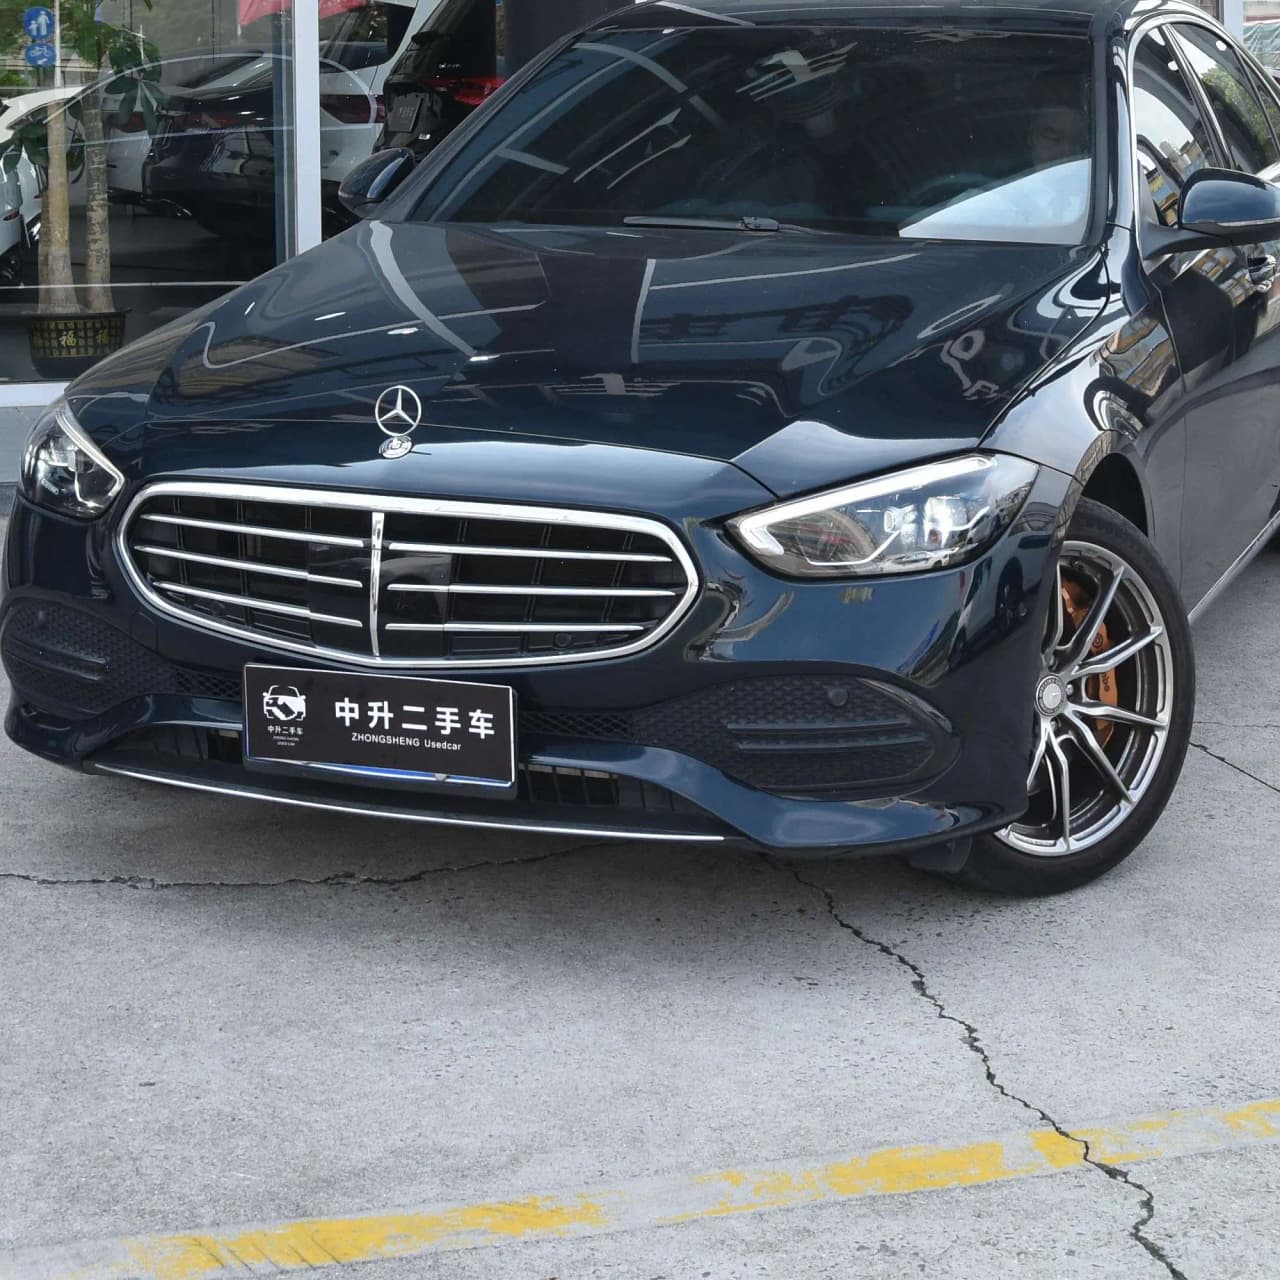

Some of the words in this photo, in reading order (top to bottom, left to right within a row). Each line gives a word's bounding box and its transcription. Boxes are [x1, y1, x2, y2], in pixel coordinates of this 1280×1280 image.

[334, 696, 496, 740] 中升二手车
[267, 724, 304, 736] 中升二手车
[351, 731, 421, 748] ZHONGSHENG
[423, 738, 462, 751] Usedcar
